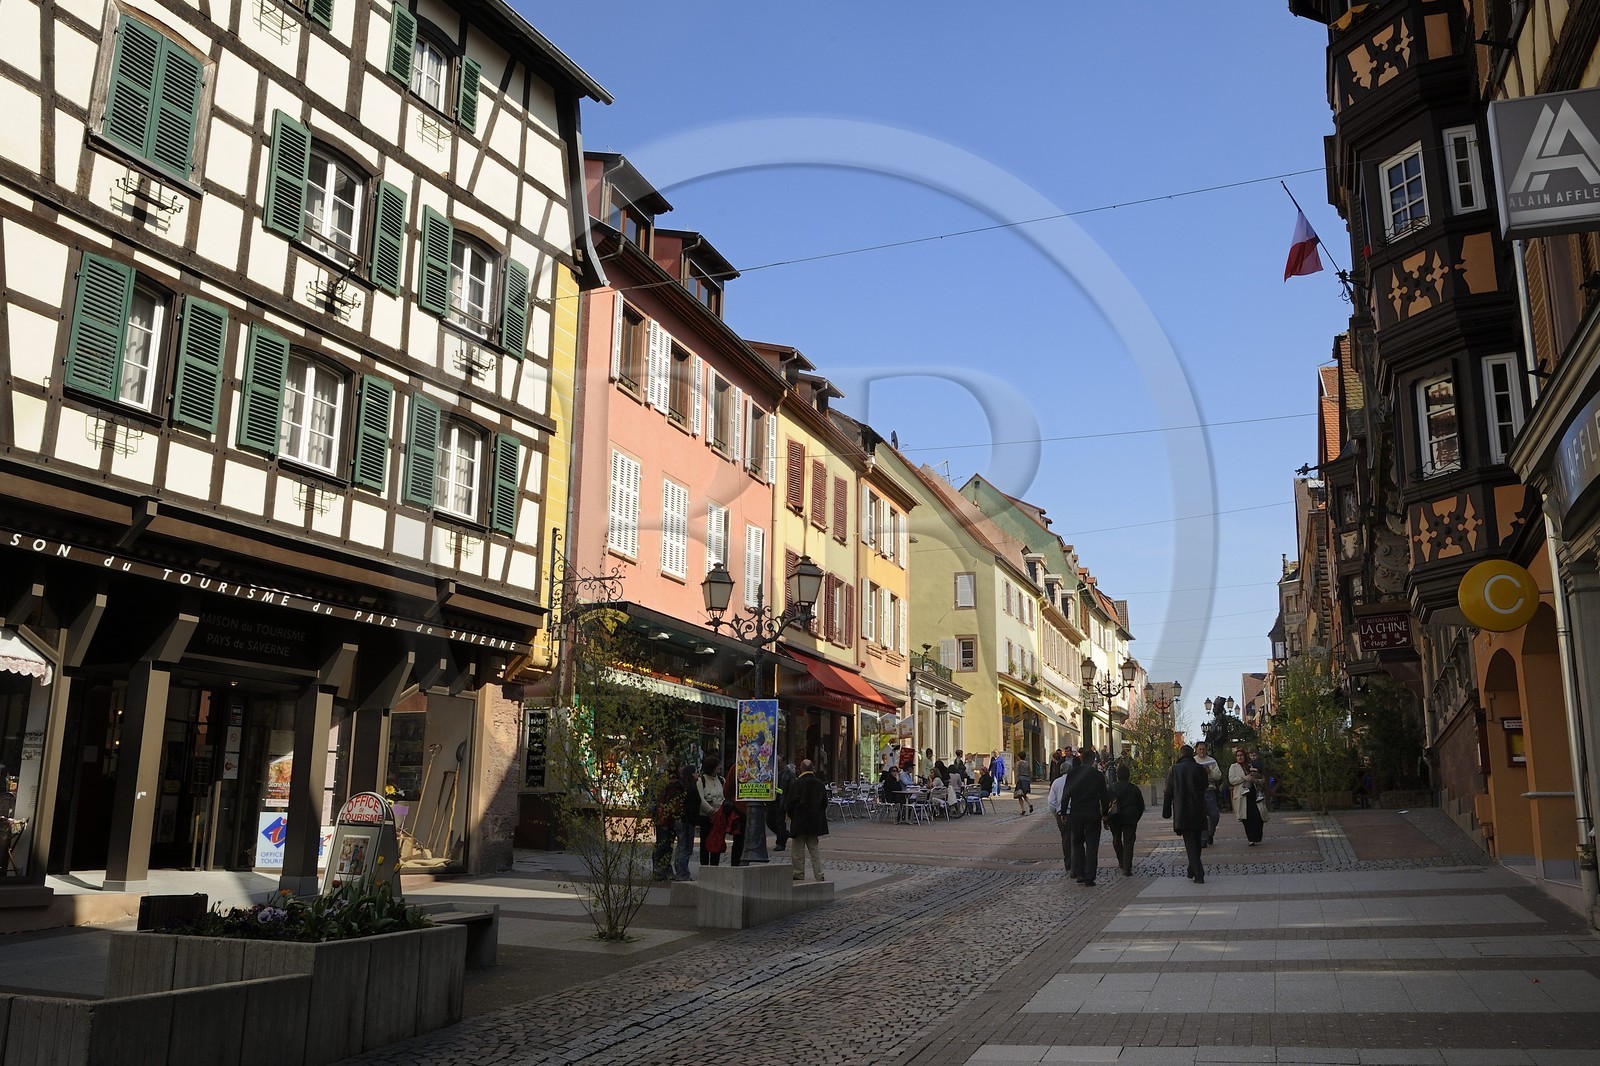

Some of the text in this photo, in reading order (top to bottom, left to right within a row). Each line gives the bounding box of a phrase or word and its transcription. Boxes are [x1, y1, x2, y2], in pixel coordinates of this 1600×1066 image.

[1509, 193, 1551, 208] ALAIN
[9, 533, 516, 651] SON du TOURISME du PAYS de SAVERNE
[241, 620, 253, 632] du
[256, 623, 307, 642] TOURISME
[1361, 621, 1408, 635] LA CHINE
[206, 633, 291, 657] PAYS de SAVERNE
[347, 795, 380, 814] OFFICE
[341, 812, 383, 823] TOURISME
